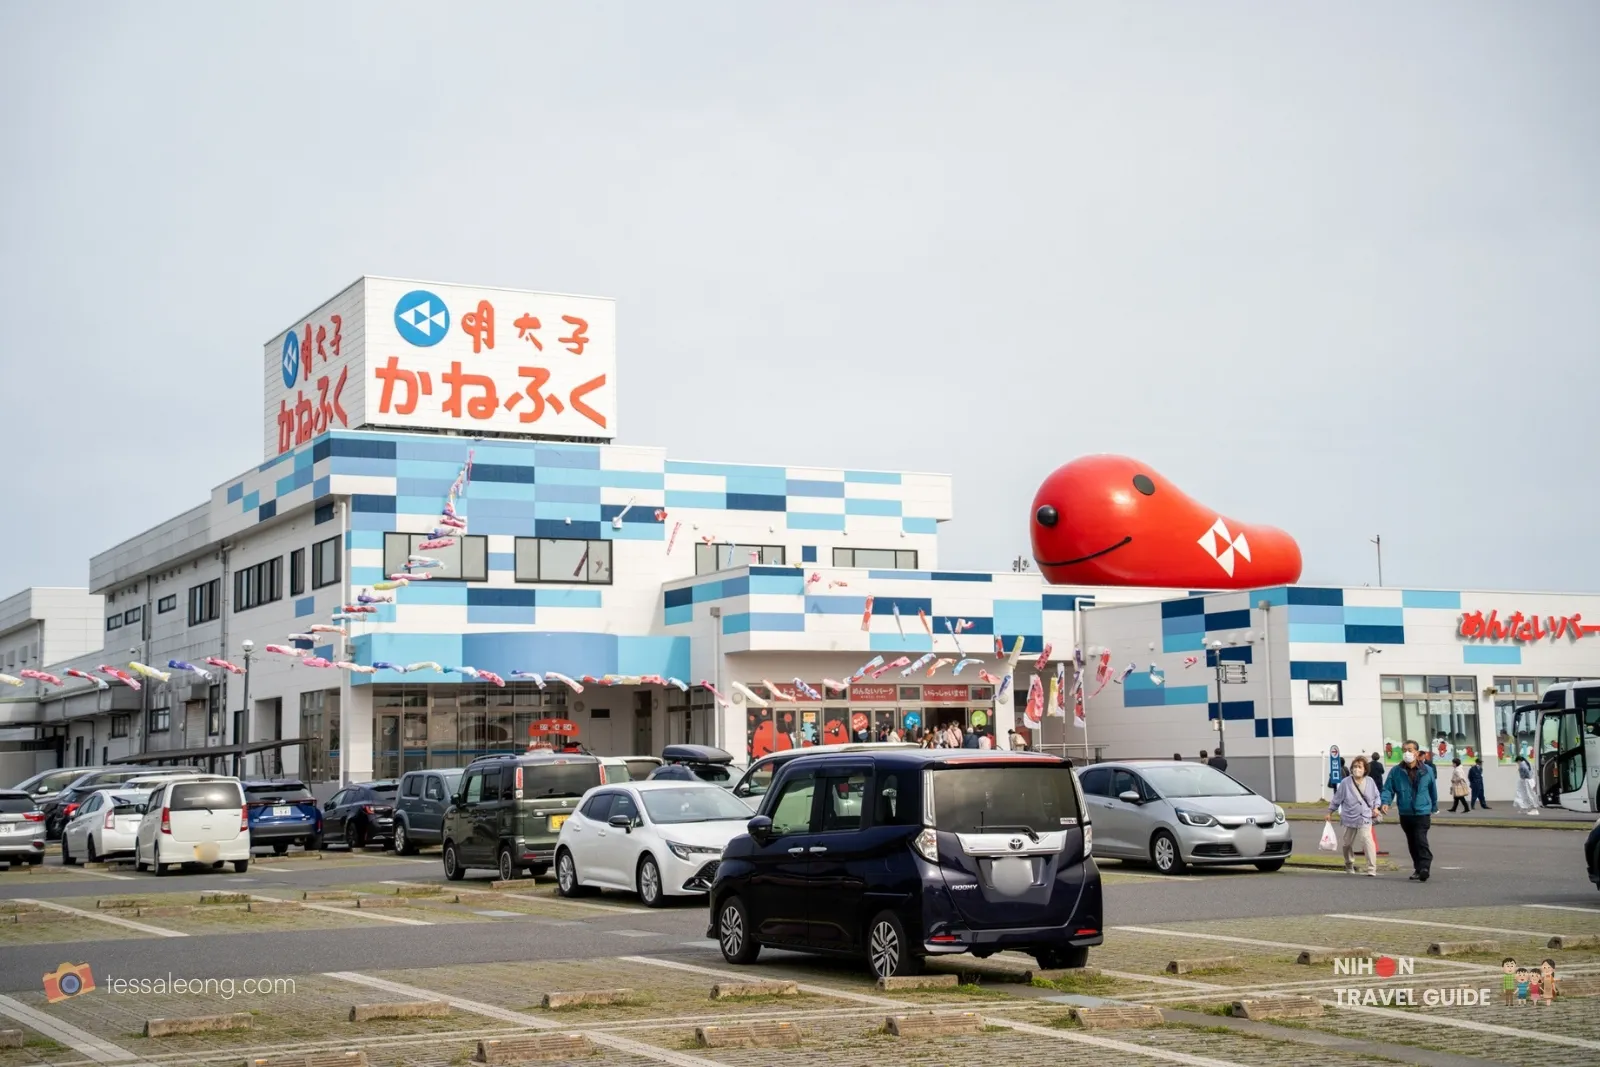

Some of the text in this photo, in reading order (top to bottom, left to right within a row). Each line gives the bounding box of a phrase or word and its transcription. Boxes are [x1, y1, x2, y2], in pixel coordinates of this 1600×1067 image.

[301, 314, 342, 382] 明太子
[461, 300, 590, 355] 明太子
[277, 364, 347, 454] かねふく
[375, 356, 606, 429] かねふく
[852, 686, 894, 695] めんたいパーク
